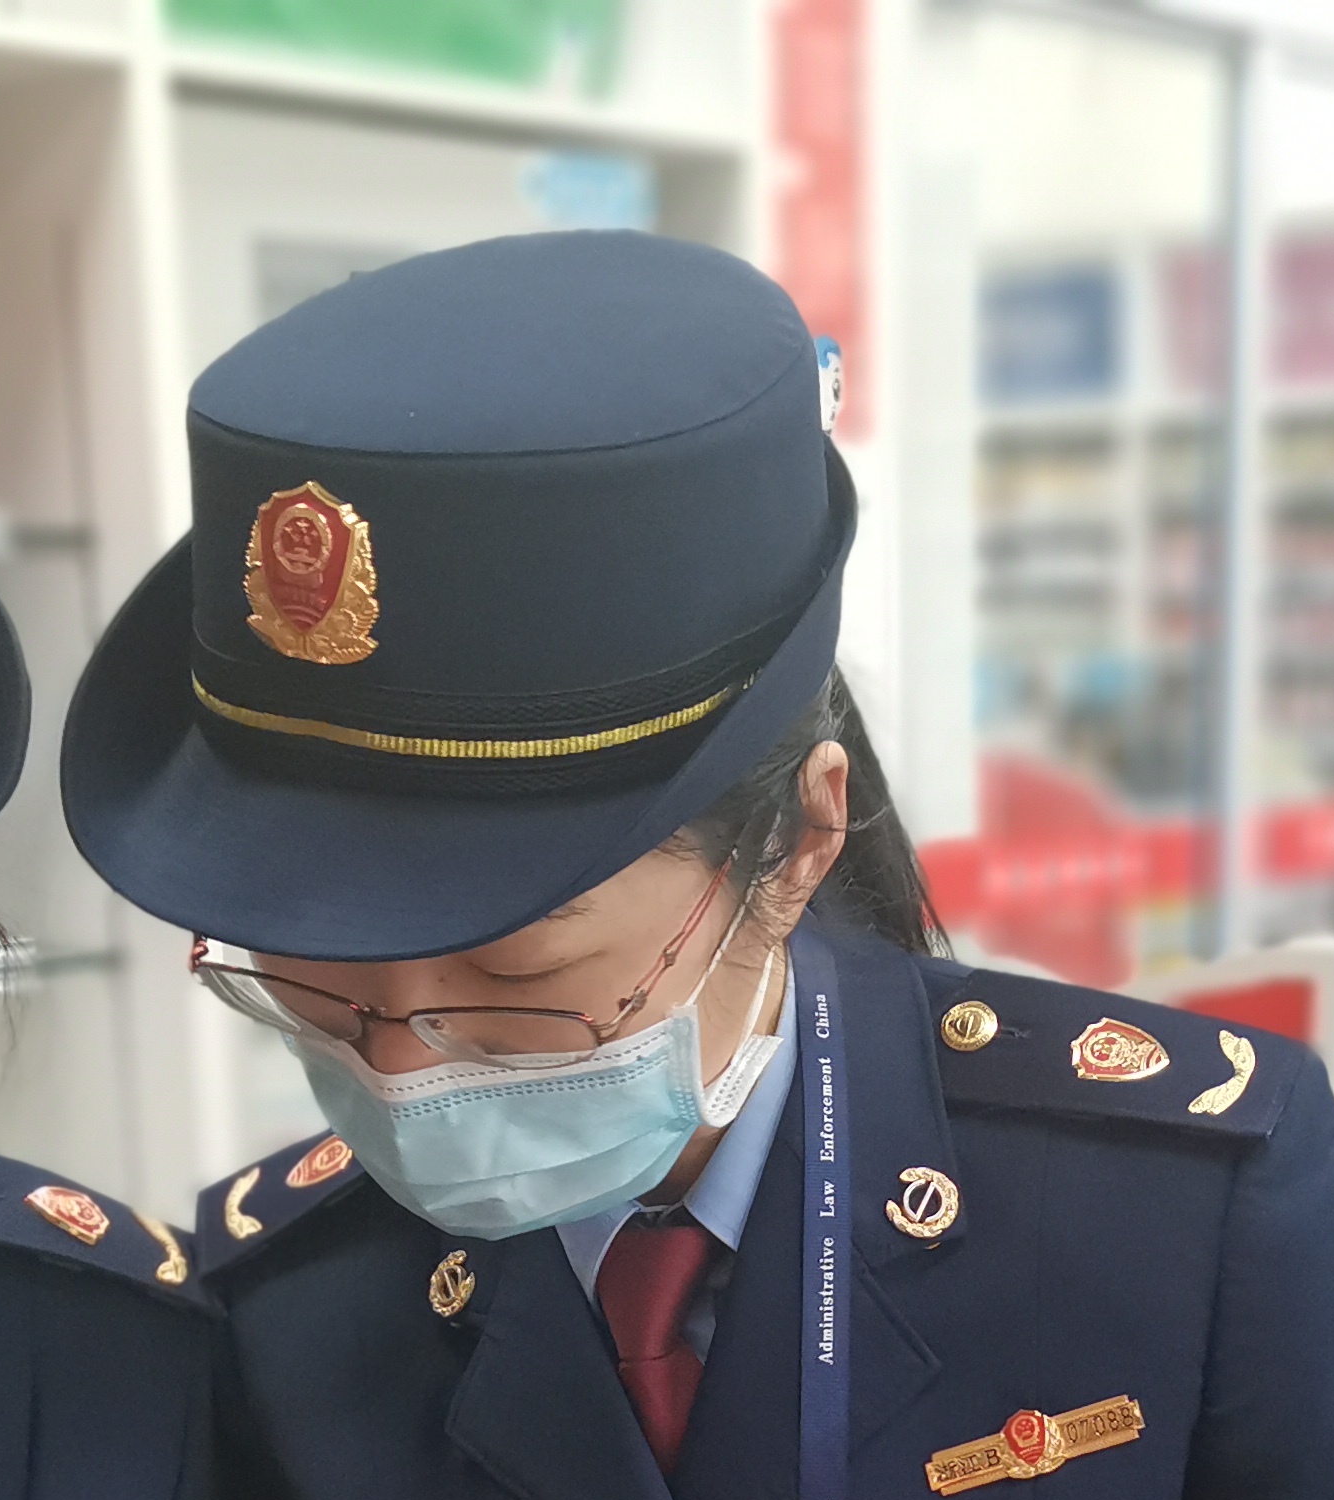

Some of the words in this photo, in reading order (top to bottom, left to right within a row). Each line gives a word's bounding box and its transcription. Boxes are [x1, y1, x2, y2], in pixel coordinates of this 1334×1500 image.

[815, 994, 830, 1038] China
[819, 1056, 835, 1162] Enforcement
[820, 1181, 835, 1218] Law
[818, 1237, 835, 1365] Administrative
